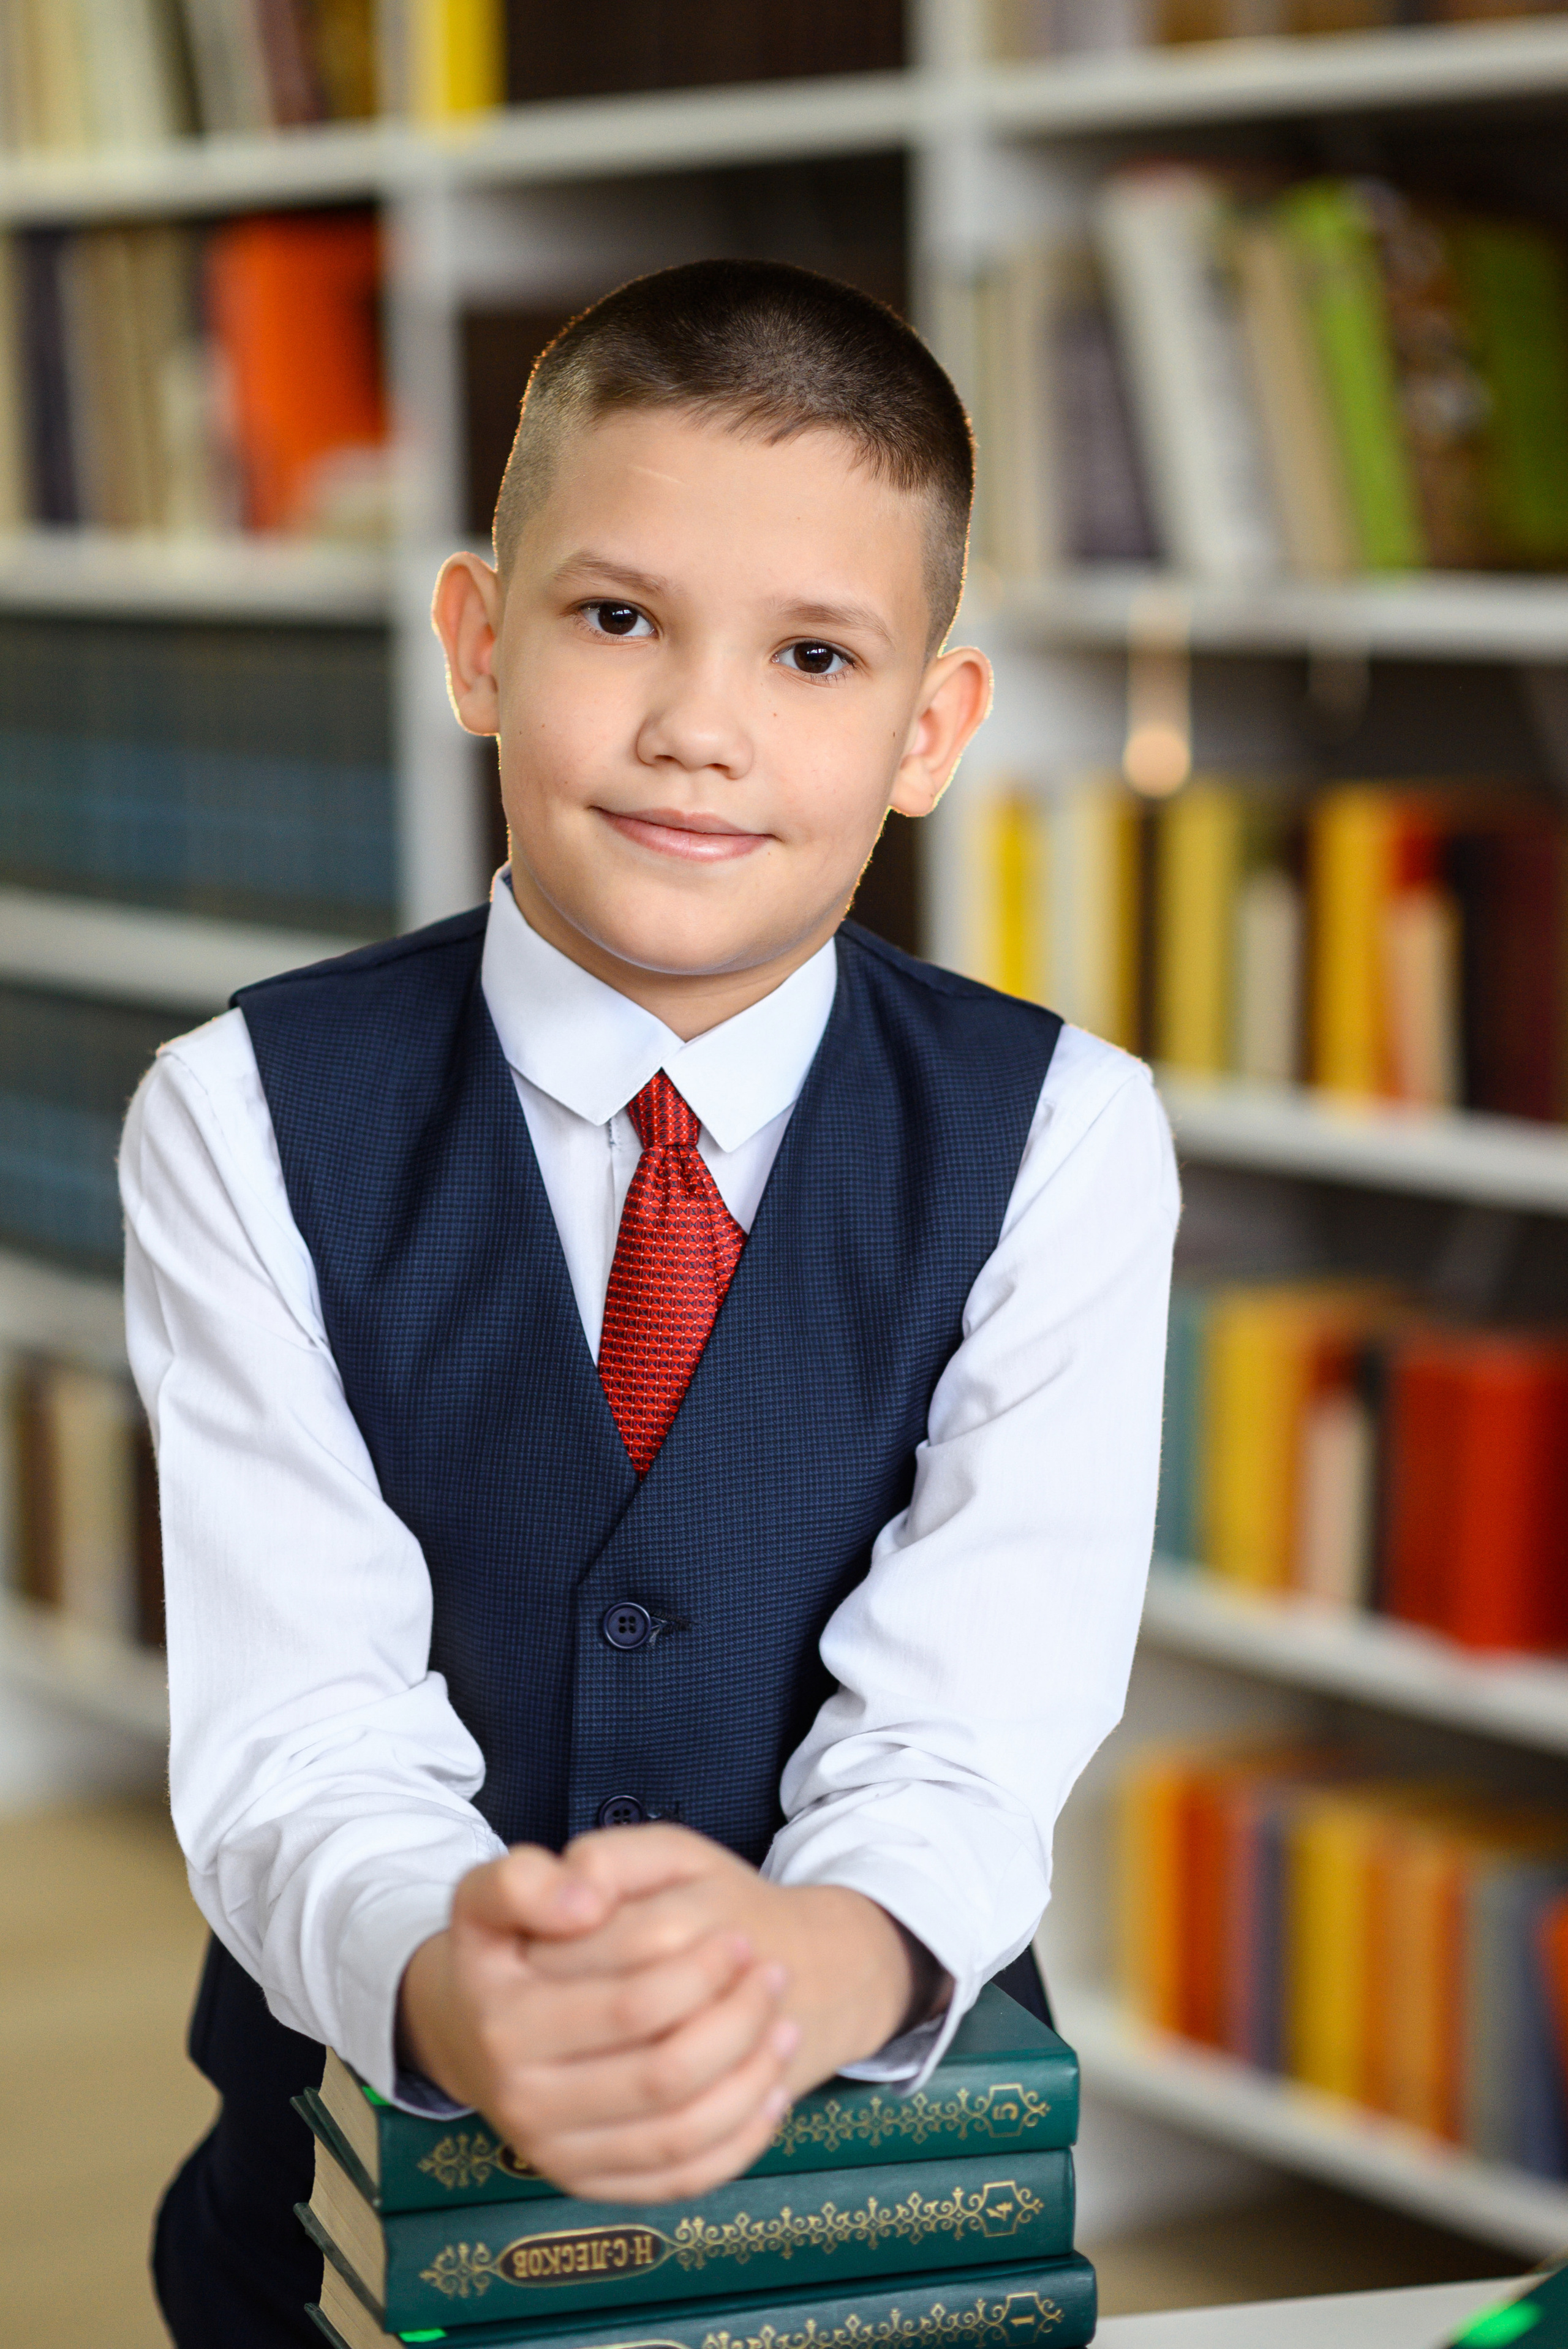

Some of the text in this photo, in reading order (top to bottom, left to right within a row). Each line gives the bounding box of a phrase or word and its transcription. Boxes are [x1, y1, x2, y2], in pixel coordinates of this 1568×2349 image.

[992, 2102, 1019, 2120] 5
[986, 2201, 1012, 2221] 4
[1011, 2315, 1035, 2326] 1
